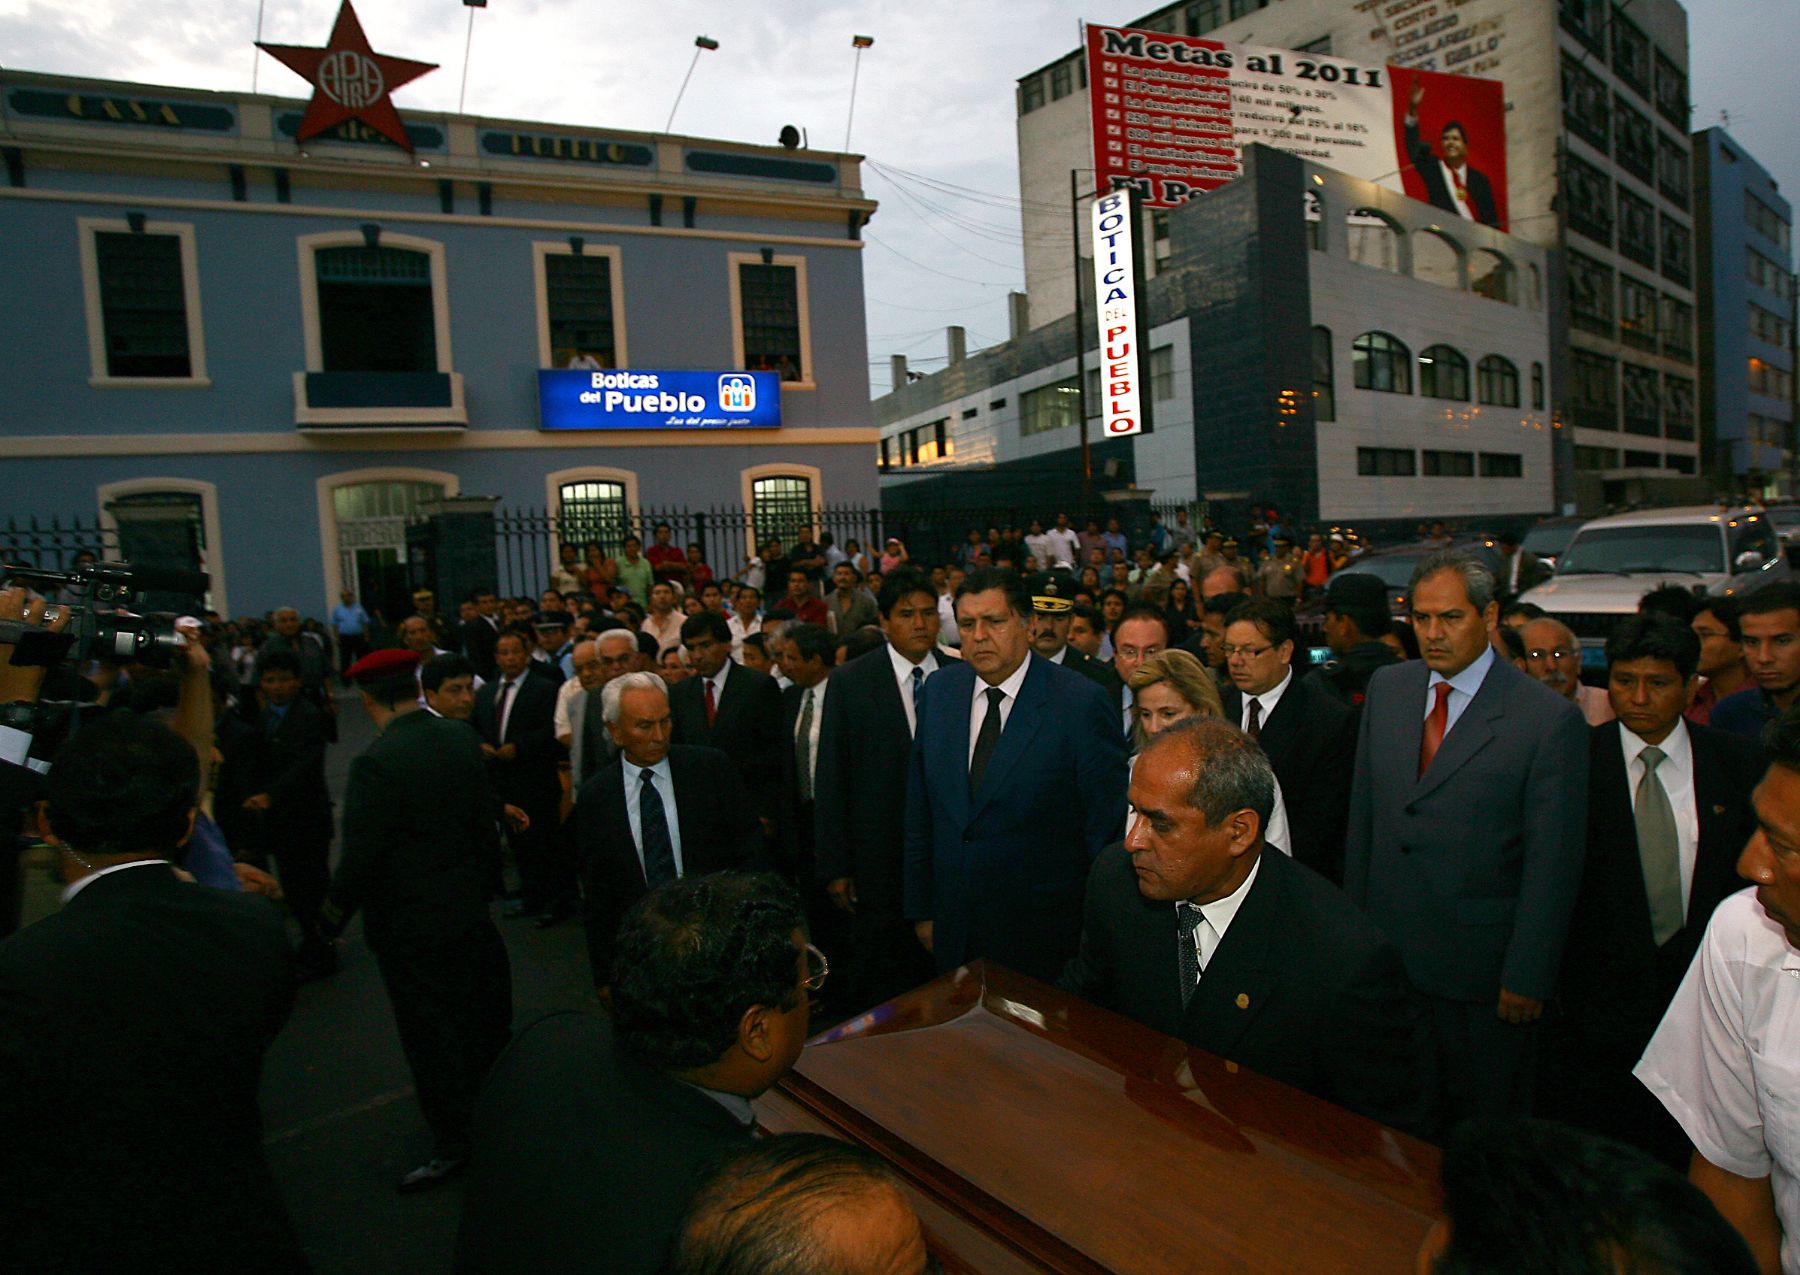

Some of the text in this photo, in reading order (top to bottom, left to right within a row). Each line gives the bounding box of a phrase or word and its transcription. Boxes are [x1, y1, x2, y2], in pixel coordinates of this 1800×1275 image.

[1102, 29, 1234, 69] Metas
[1246, 53, 1284, 76] al
[1295, 60, 1383, 88] 2011
[1122, 63, 1140, 76] La
[1142, 68, 1191, 81] pobreza
[1193, 75, 1209, 84] se
[1262, 82, 1276, 92] de
[1124, 80, 1138, 91] El
[1255, 97, 1272, 106] mil
[1123, 95, 1142, 108] La
[1221, 109, 1236, 119] se
[1151, 116, 1172, 128] mil
[1174, 118, 1232, 134] viviendas
[1234, 126, 1260, 136] para
[1295, 131, 1312, 141] mil
[1152, 132, 1173, 144] mil
[1175, 135, 1218, 147] nuevos
[1127, 143, 1142, 155] El
[1128, 159, 1143, 171] El
[1145, 163, 1190, 176] empleo
[1098, 194, 1135, 433] BOTICA DEL PUEBLO
[591, 372, 659, 389] Boticas
[579, 391, 706, 413] del Pueblo
